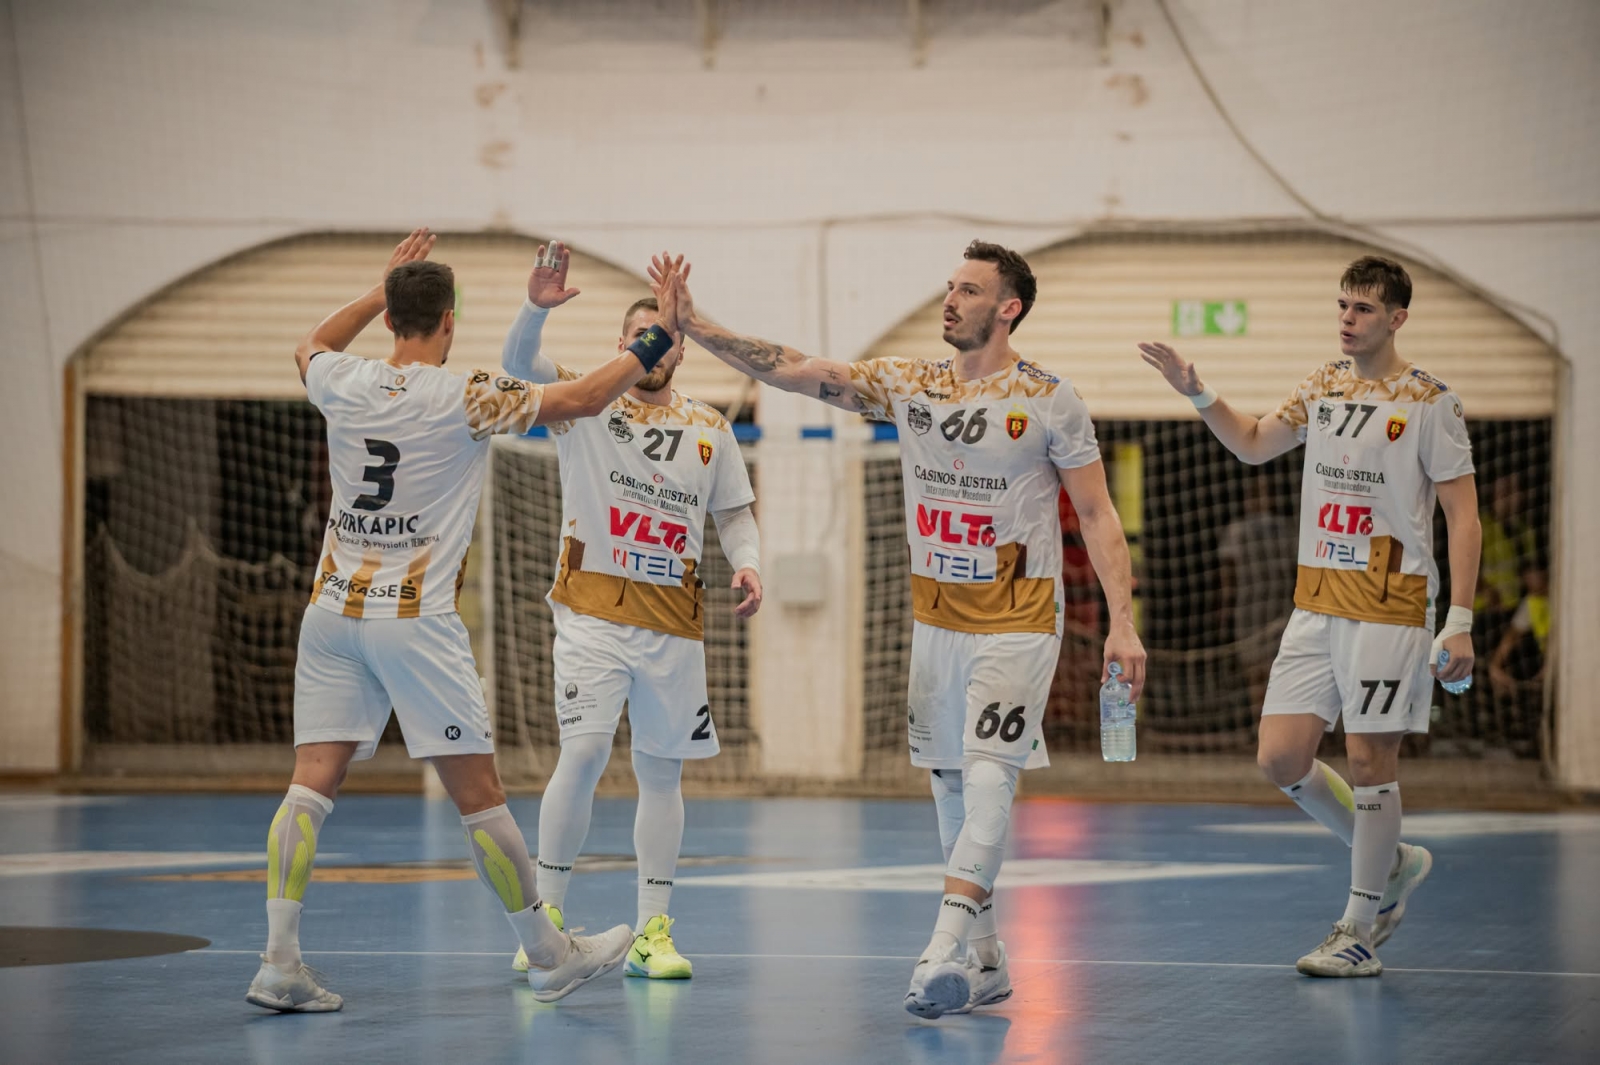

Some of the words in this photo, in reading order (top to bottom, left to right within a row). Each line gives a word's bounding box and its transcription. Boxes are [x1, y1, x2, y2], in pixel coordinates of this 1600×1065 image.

[940, 407, 988, 445] 66
[1335, 403, 1378, 438] 77
[642, 427, 684, 462] 27
[351, 438, 400, 511] 3
[914, 464, 957, 486] CASINOS
[959, 475, 1008, 490] AUSTRIA
[925, 483, 961, 499] International
[962, 489, 992, 502] Macedonia
[609, 505, 688, 549] VLT
[916, 503, 993, 546] VLT
[372, 541, 408, 550] Physiofit
[1360, 679, 1401, 715] 77
[691, 703, 711, 741] 2
[975, 701, 1026, 743] 66
[1356, 803, 1382, 811] SELECT
[538, 858, 572, 872] Kempa
